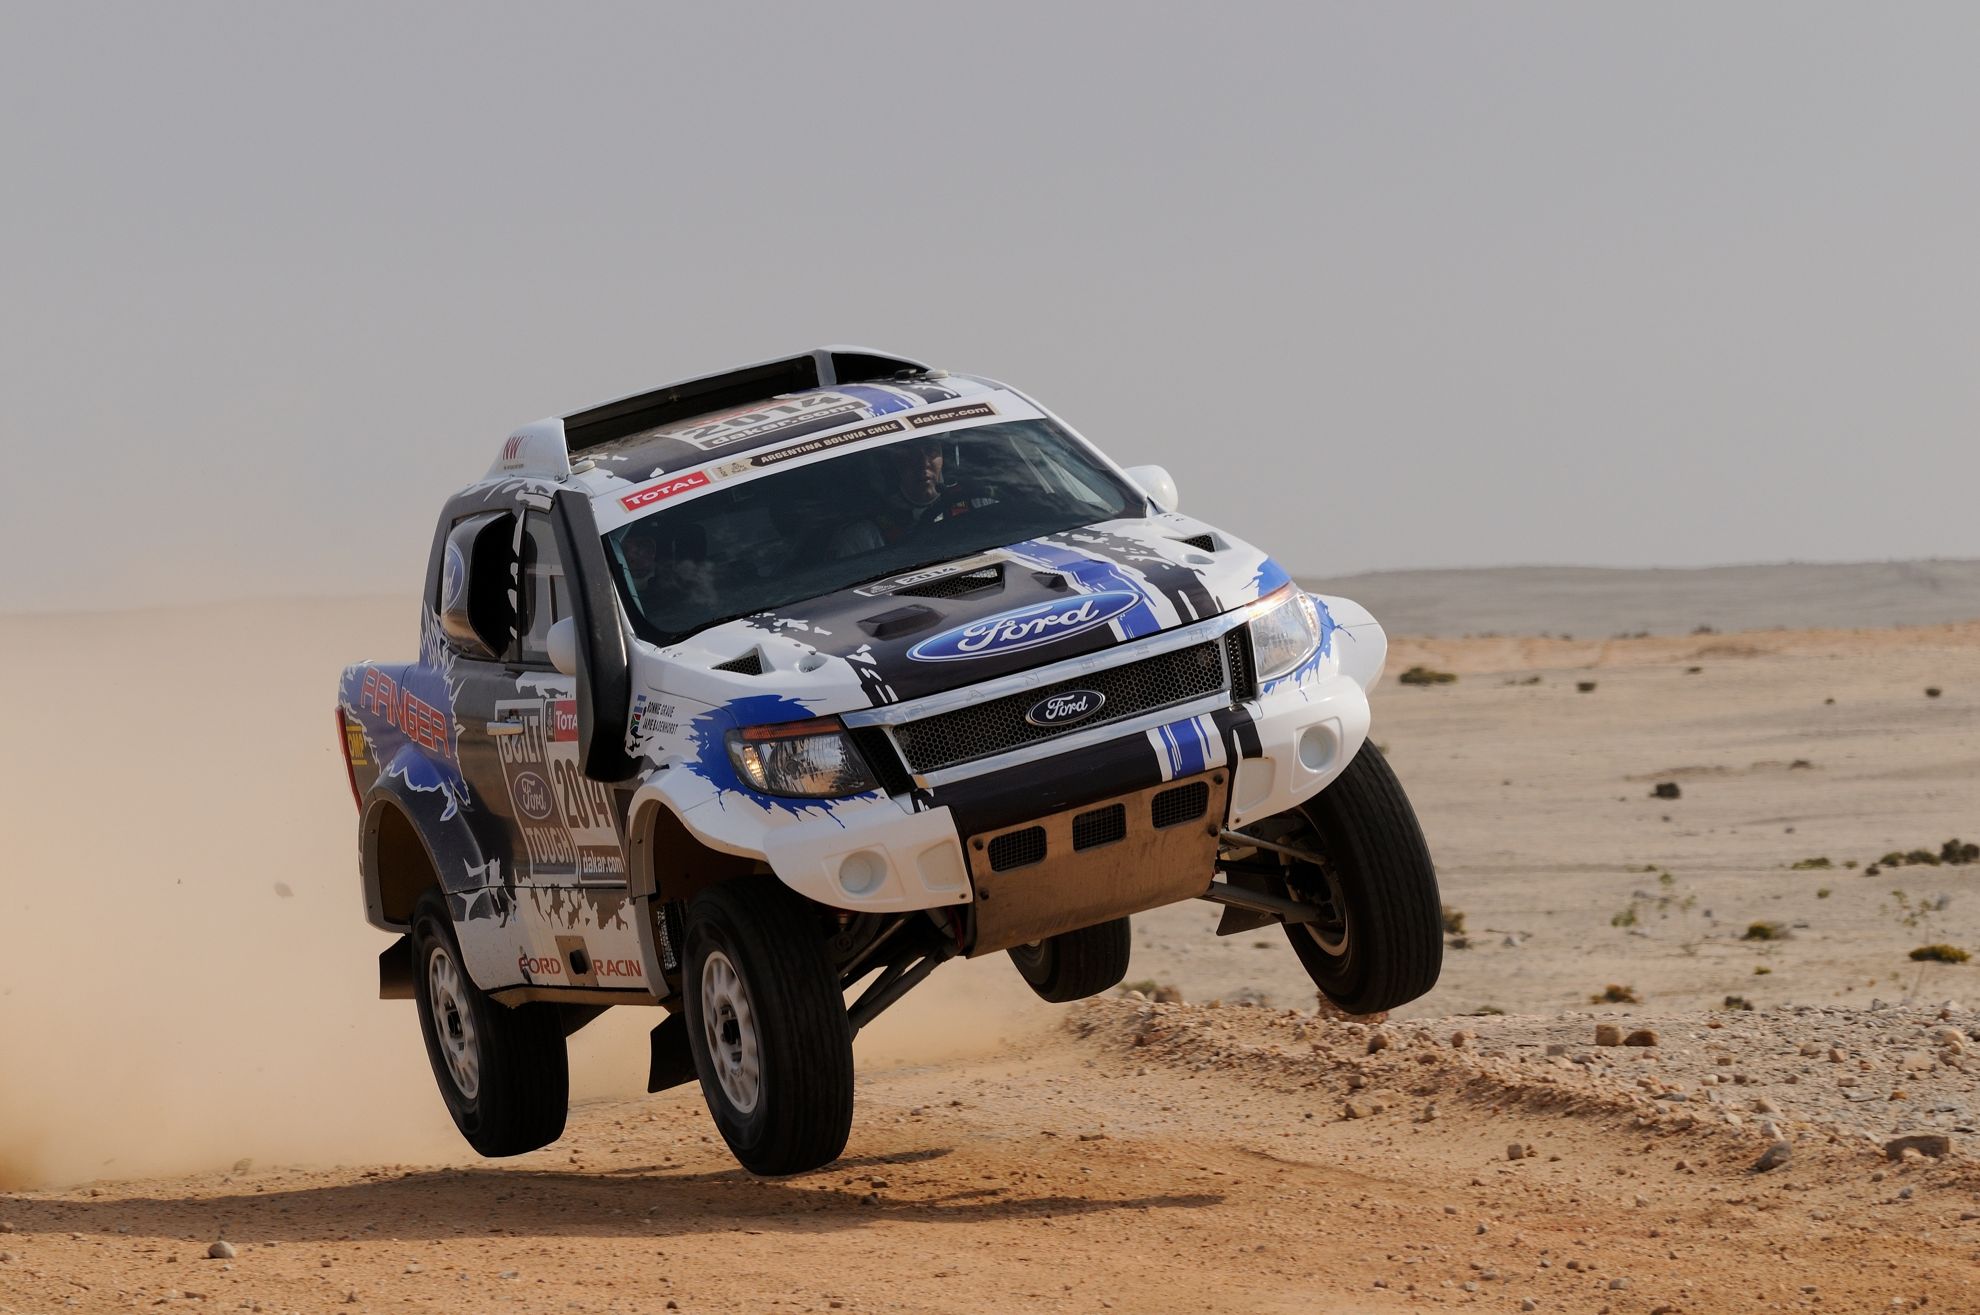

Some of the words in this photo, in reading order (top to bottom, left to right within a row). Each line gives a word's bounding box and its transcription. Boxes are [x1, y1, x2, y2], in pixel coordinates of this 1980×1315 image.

[682, 396, 843, 440] 2014
[711, 404, 857, 446] dakar.com
[913, 406, 989, 425] dakar.com
[760, 441, 823, 463] ARGENTINA
[823, 430, 867, 447] BOLIVIA
[868, 422, 899, 436] CHILE
[626, 478, 704, 505] TOTAL
[957, 600, 1100, 652] Ford
[361, 666, 451, 758] RANGER
[1045, 694, 1089, 720] Ford
[500, 716, 542, 764] BUILT
[521, 778, 546, 811] Ford
[554, 758, 611, 829] 2014
[525, 827, 576, 864] TOUGH
[582, 850, 624, 873] dakar.com
[518, 957, 561, 975] FORD
